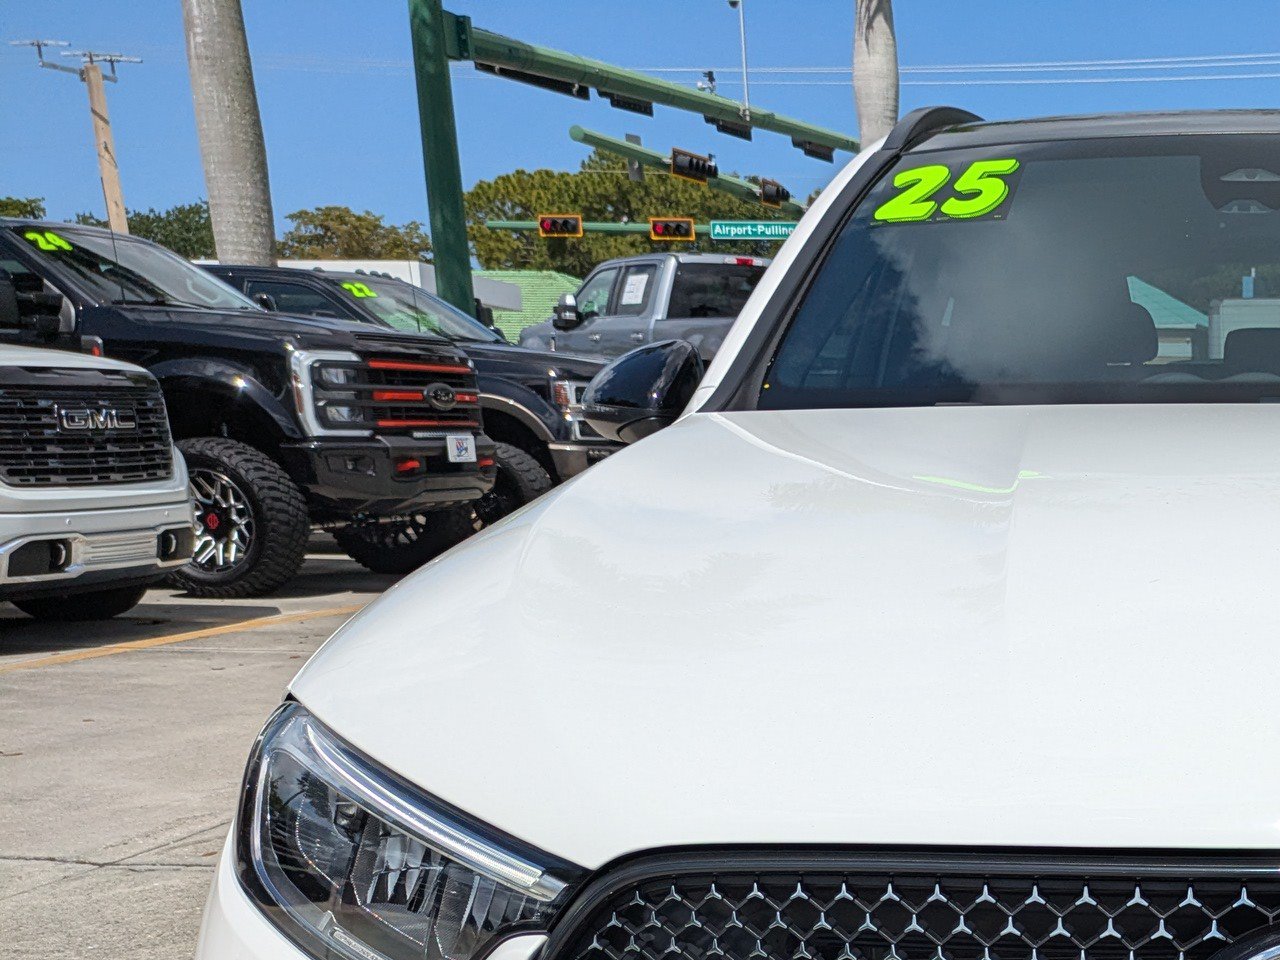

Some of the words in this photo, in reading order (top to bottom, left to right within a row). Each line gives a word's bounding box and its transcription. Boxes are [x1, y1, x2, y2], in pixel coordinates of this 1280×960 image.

[874, 159, 1019, 222] 25
[26, 232, 72, 250] 24
[341, 282, 378, 298] 22
[60, 409, 136, 429] GMC
